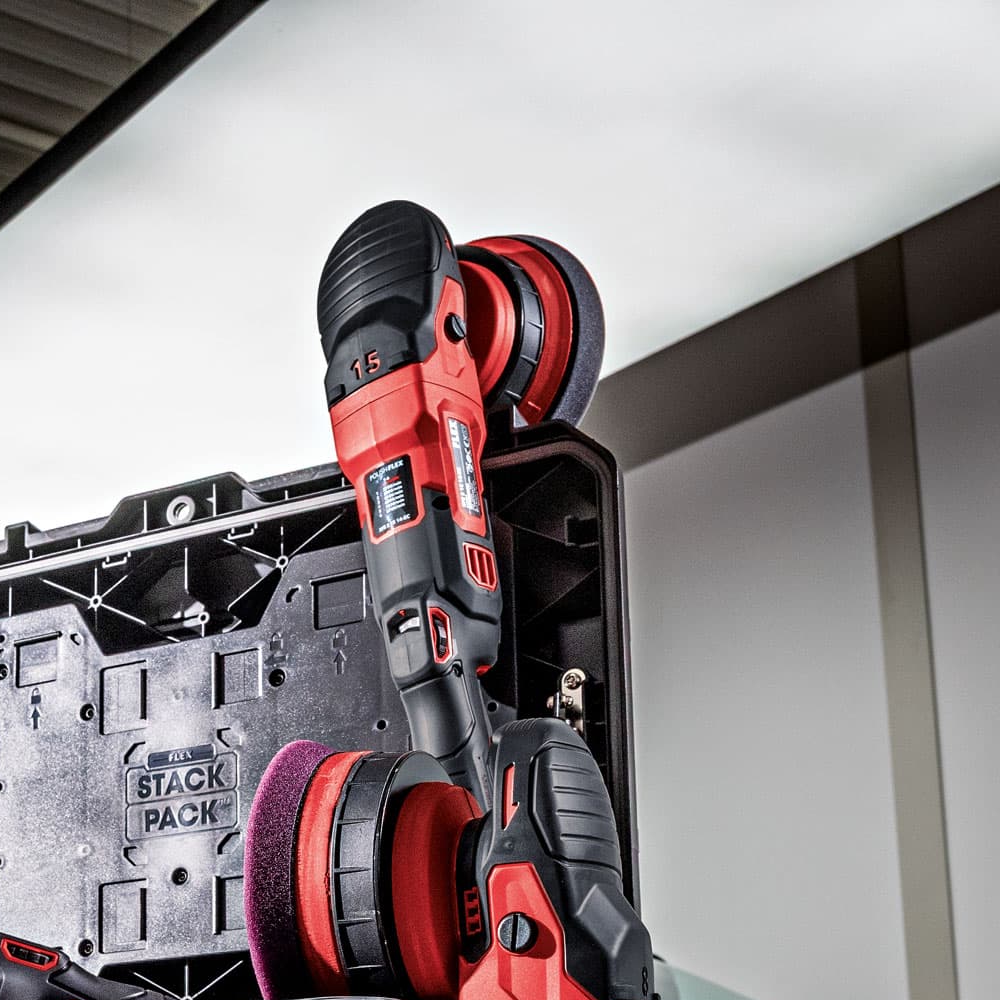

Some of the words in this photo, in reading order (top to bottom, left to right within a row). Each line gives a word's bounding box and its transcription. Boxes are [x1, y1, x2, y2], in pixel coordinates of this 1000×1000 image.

[350, 349, 380, 380] 15
[168, 750, 194, 763] FLEX
[137, 762, 225, 799] STACK
[144, 799, 218, 833] PACK
